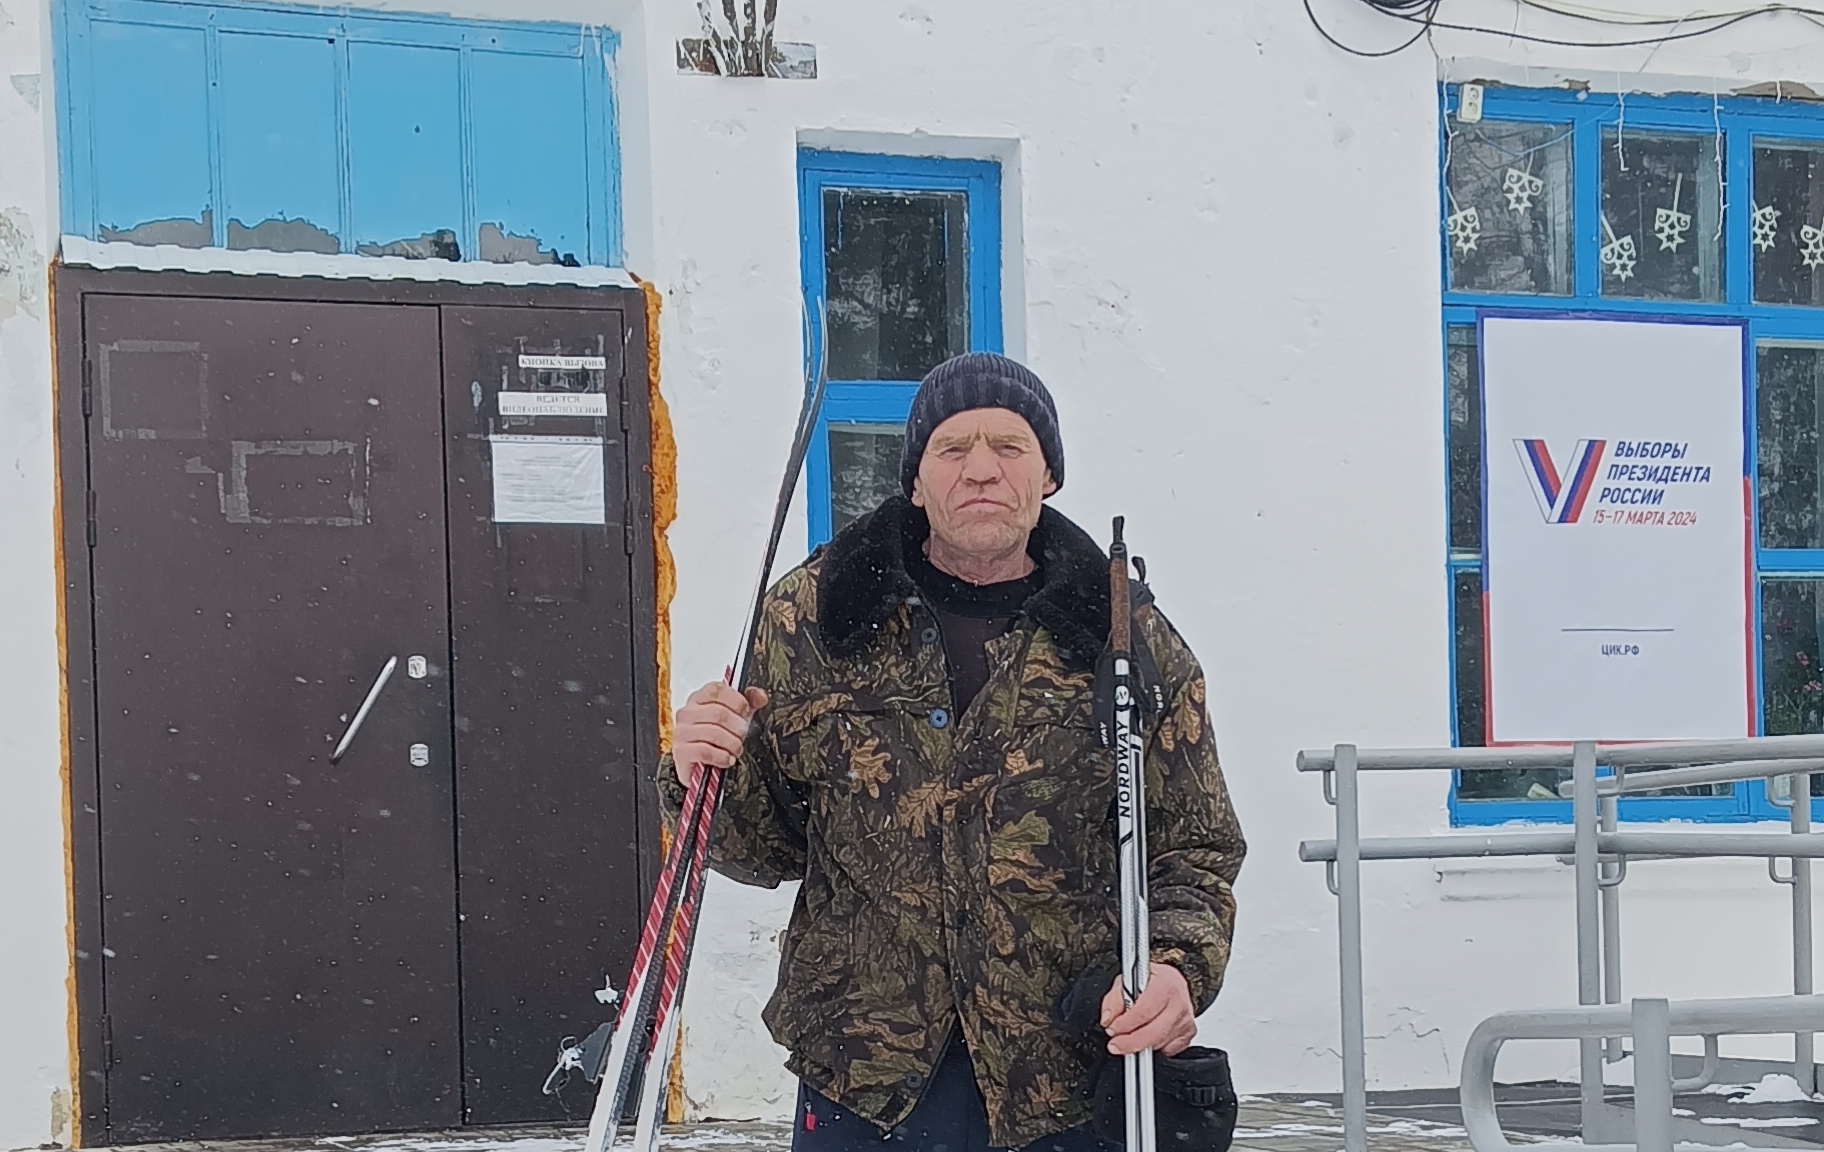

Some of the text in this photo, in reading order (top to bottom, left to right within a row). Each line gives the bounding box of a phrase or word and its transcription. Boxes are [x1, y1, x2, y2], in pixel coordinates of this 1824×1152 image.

[521, 358, 563, 367] КНОПКА
[1614, 441, 1689, 459] ВЫБОРЫ
[1607, 464, 1711, 484] ПРЕЗИДЕНТА
[1599, 487, 1665, 505] РОССИИ
[1625, 511, 1665, 526] МАРТА
[1667, 511, 1698, 526] 2024
[1601, 644, 1640, 657] ЦИК.РФ
[1117, 721, 1131, 818] NORDWAY
